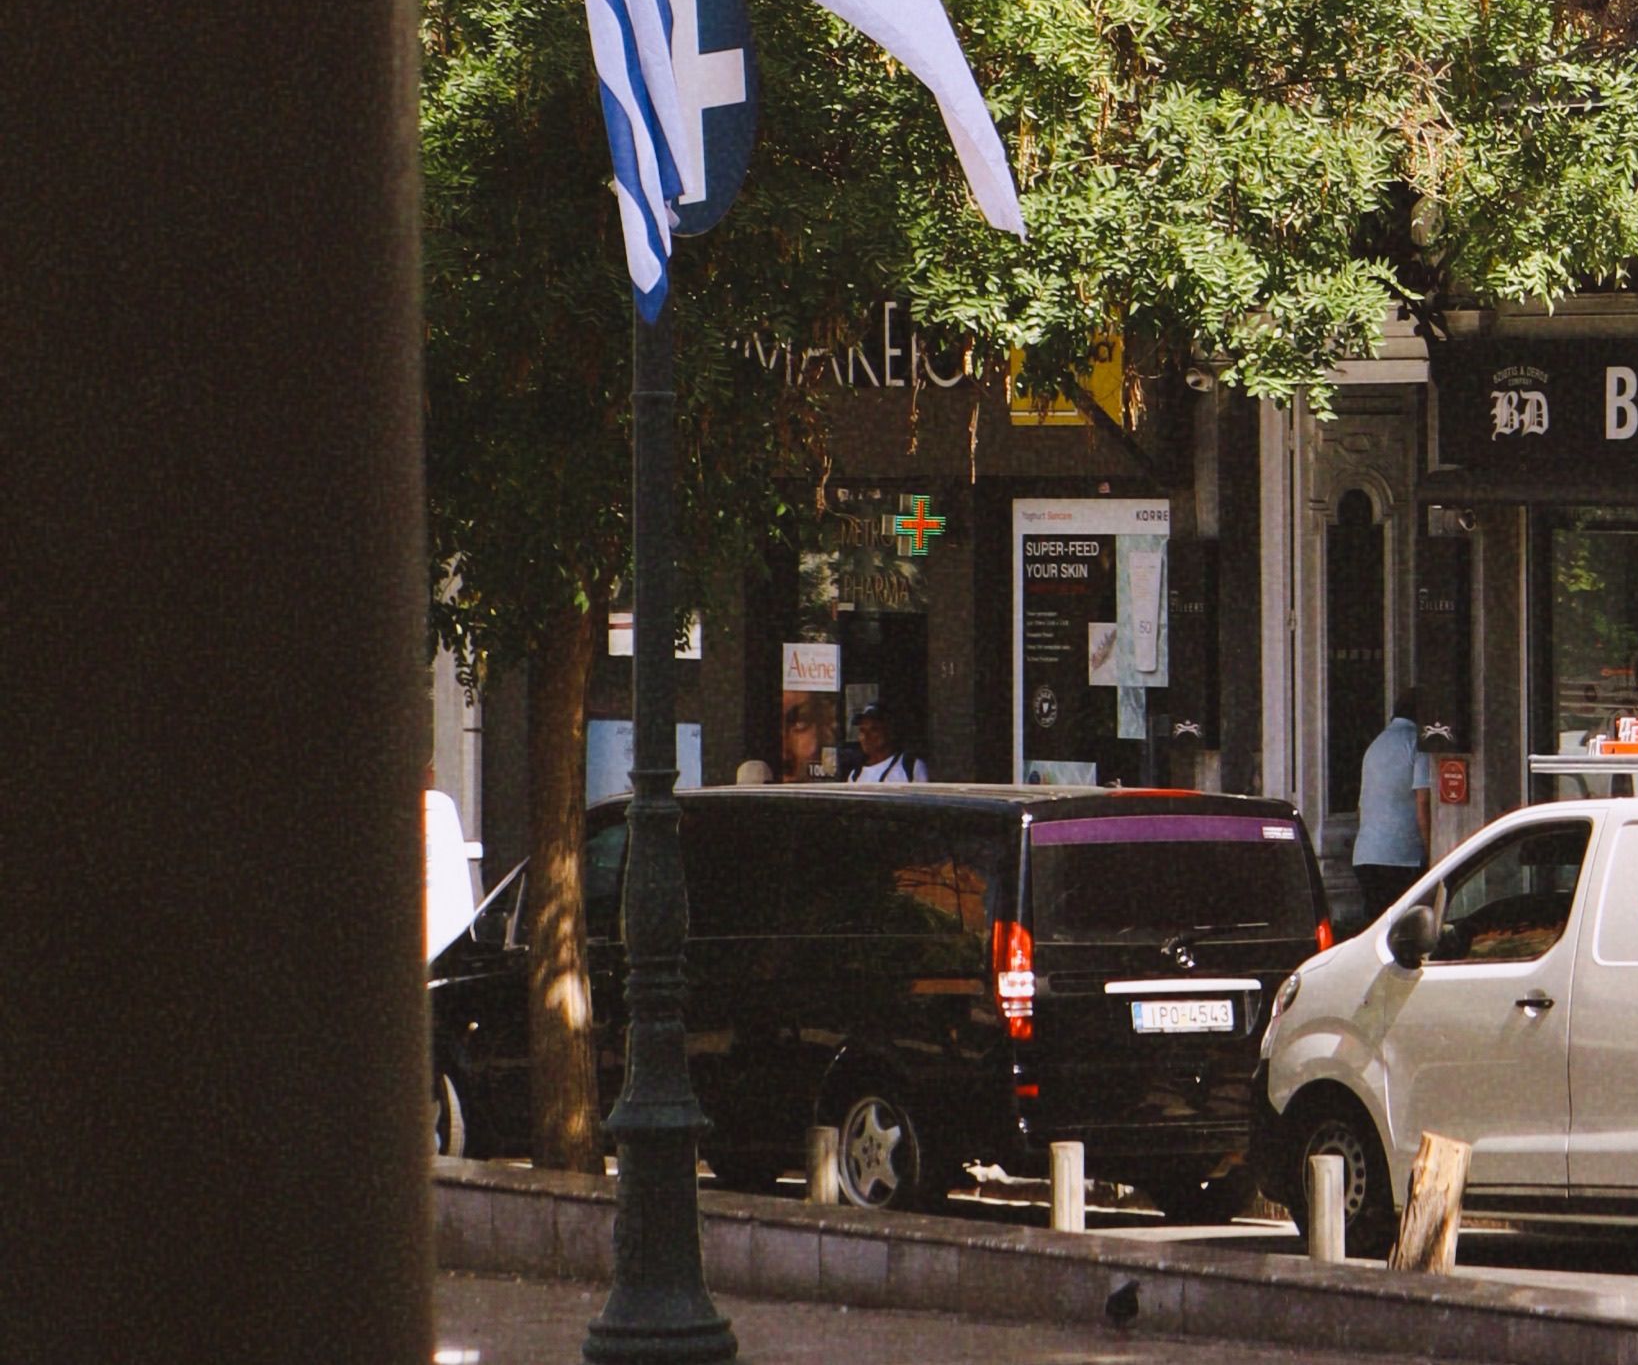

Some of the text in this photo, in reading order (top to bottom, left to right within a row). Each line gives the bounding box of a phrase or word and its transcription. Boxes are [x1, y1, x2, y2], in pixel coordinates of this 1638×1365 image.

[1025, 541, 1100, 557] SUPER-FEED
[1026, 563, 1089, 578] YOUR SKIN
